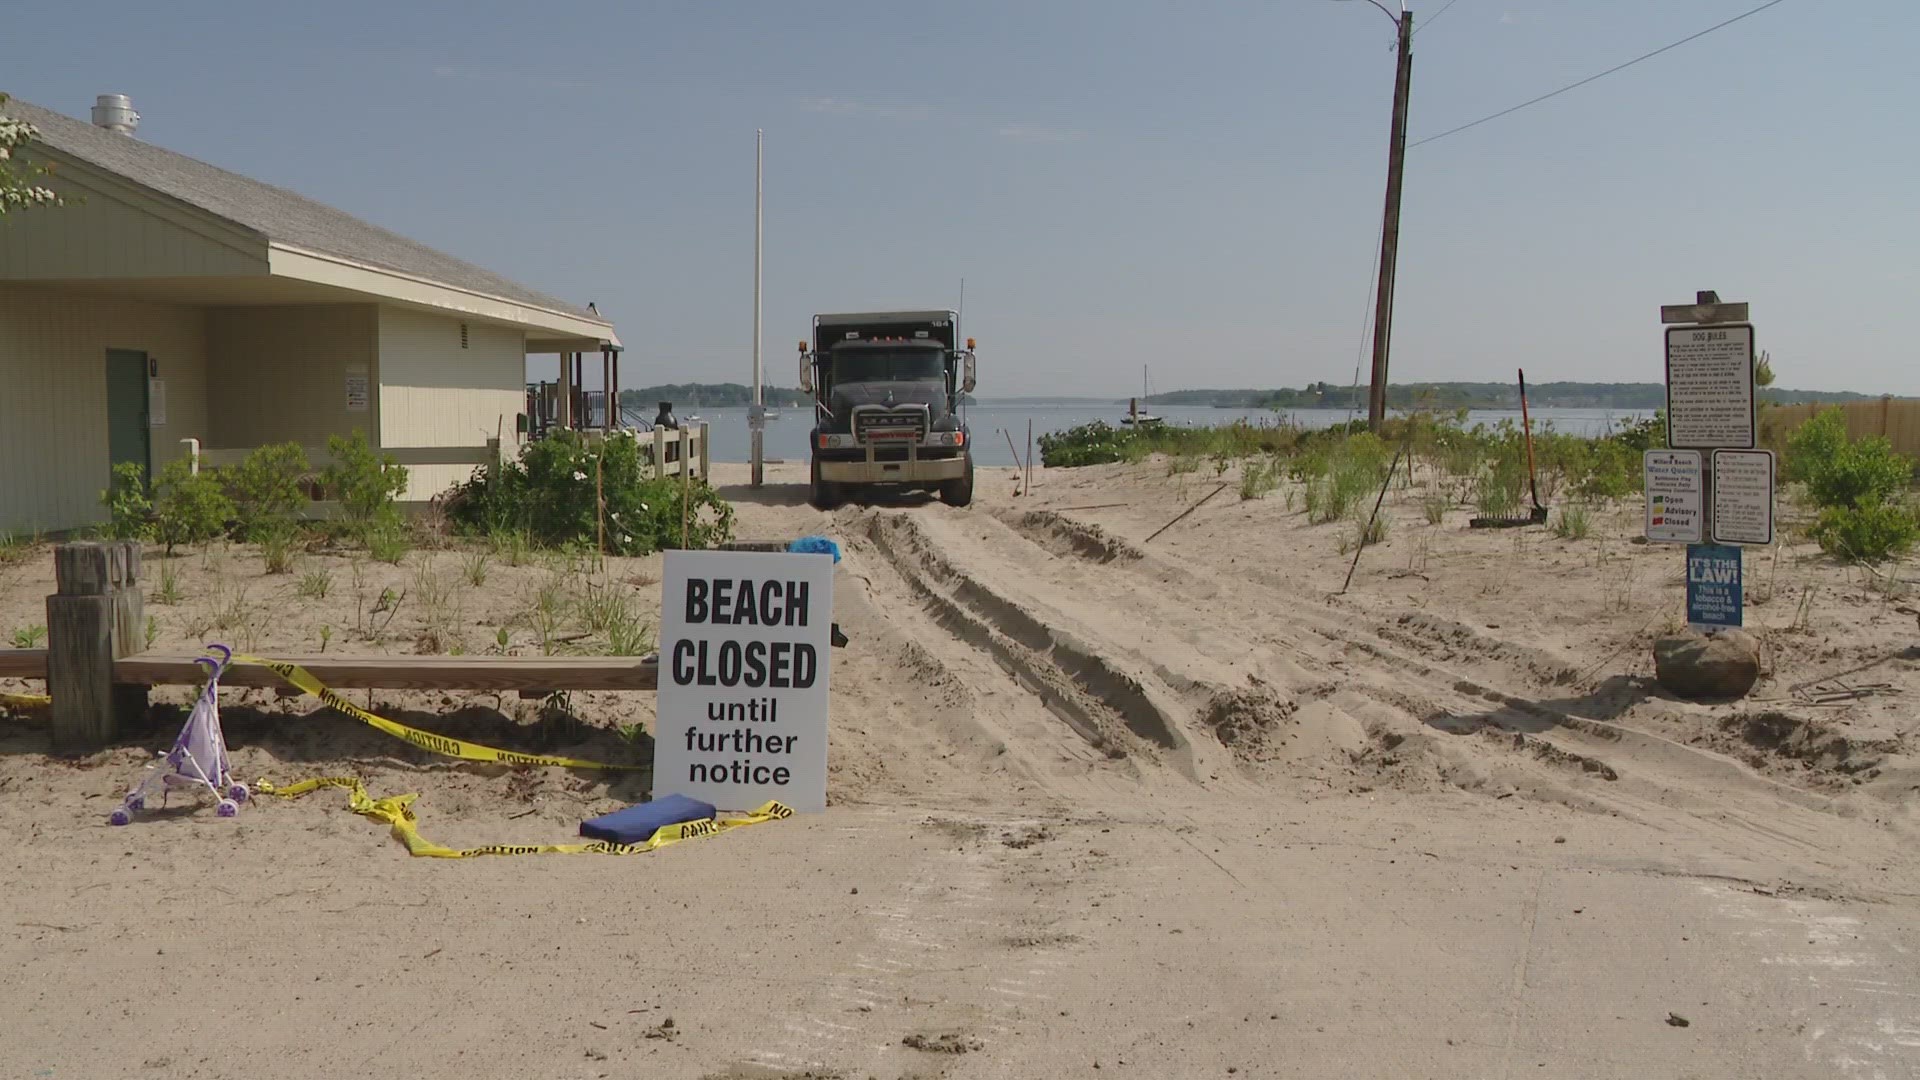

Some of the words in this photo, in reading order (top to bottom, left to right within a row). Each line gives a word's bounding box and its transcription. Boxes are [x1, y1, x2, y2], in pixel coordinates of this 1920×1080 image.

[1692, 332, 1706, 341] DOG
[1707, 331, 1727, 341] RULES
[862, 417, 919, 425] MACK
[1670, 466, 1698, 475] Quality
[1664, 496, 1684, 504] Open
[1664, 507, 1697, 517] Advisory
[1664, 517, 1690, 526] Closed
[1714, 559, 1738, 569] THE
[1689, 567, 1738, 584] LAW!
[1698, 585, 1714, 594] This
[1715, 586, 1723, 595] is
[685, 578, 809, 627] BEACH
[1695, 594, 1725, 603] tobacco
[1692, 603, 1736, 613] alcohol-free
[1702, 611, 1725, 620] beach
[672, 638, 817, 689] CLOSED
[707, 698, 777, 723] until
[685, 726, 798, 754] further
[689, 760, 791, 786] notice
